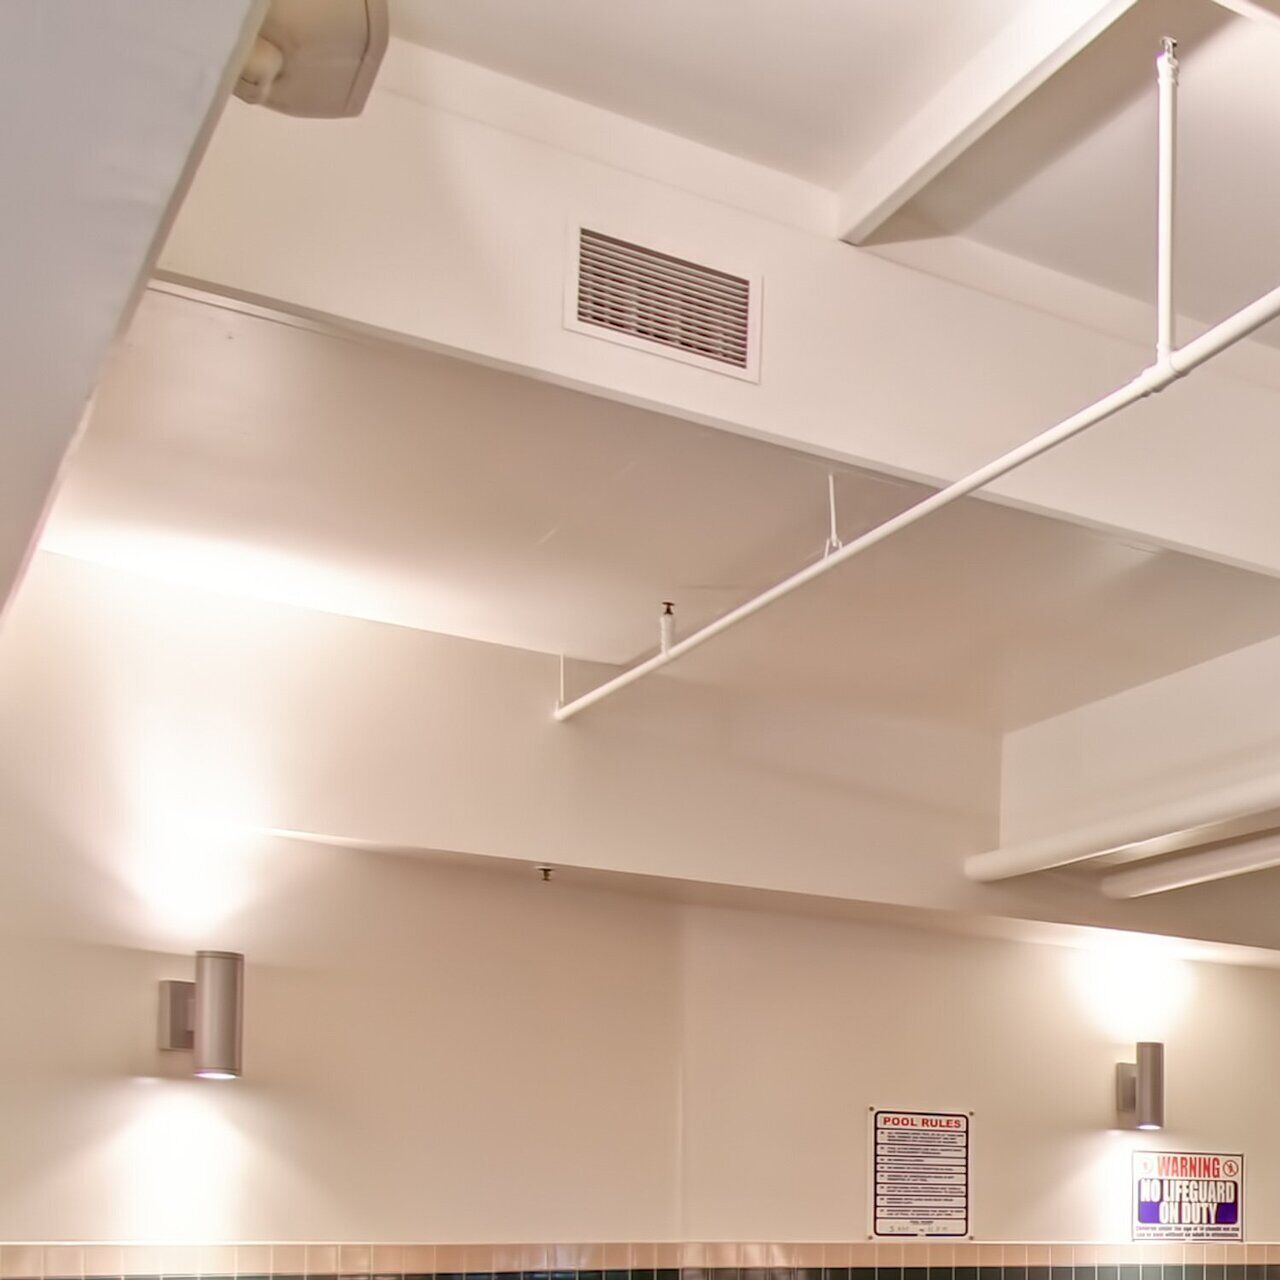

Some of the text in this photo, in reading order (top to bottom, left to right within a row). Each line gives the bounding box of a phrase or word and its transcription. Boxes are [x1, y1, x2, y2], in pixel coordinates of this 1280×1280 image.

[883, 1116, 961, 1128] POOL RULES
[1157, 1155, 1220, 1178] WARNING
[1140, 1178, 1235, 1203] NO LIFEGUARD
[1159, 1201, 1218, 1224] ON DUTY
